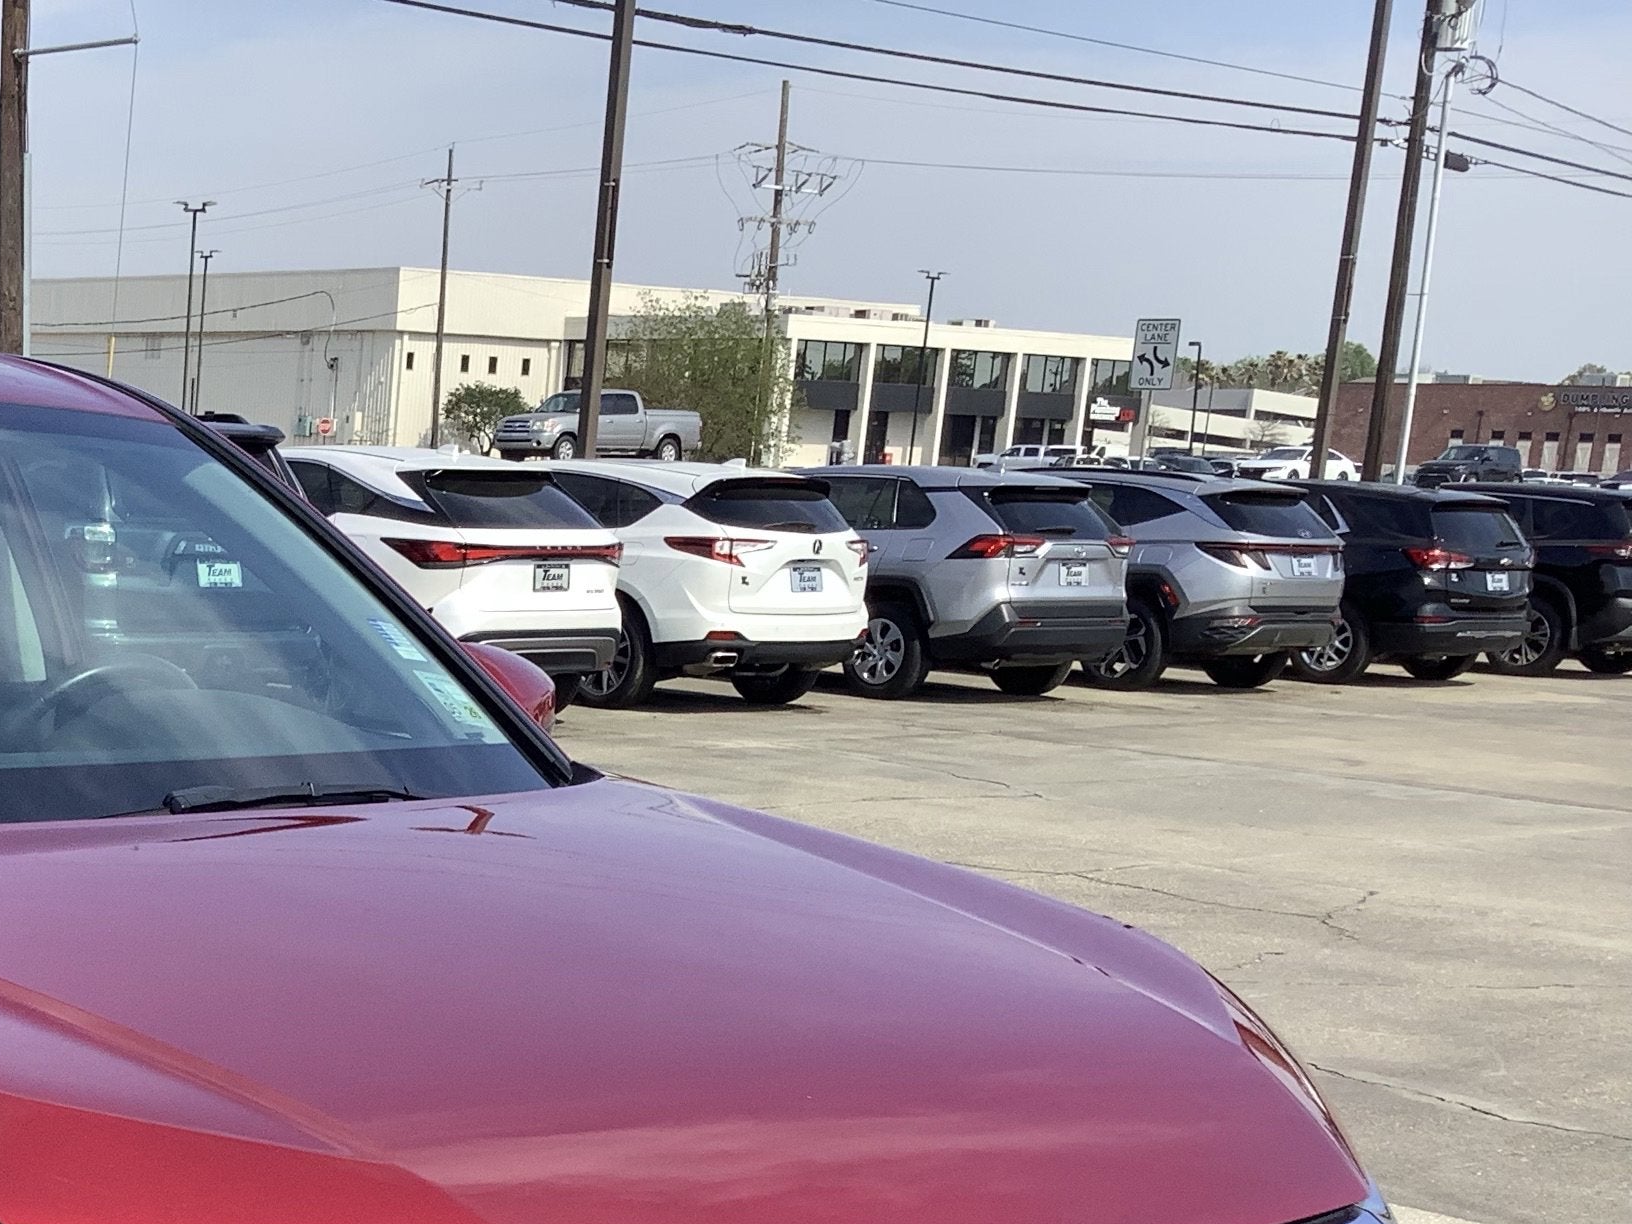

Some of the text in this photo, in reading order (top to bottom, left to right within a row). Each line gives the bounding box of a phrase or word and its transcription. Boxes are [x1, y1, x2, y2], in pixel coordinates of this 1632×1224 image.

[1141, 323, 1177, 332] CENTER
[1144, 333, 1170, 342] LANE
[1138, 377, 1164, 386] ONLY
[1560, 392, 1630, 407] DUMPING
[206, 564, 232, 578] TEAM
[542, 569, 564, 581] TEAM
